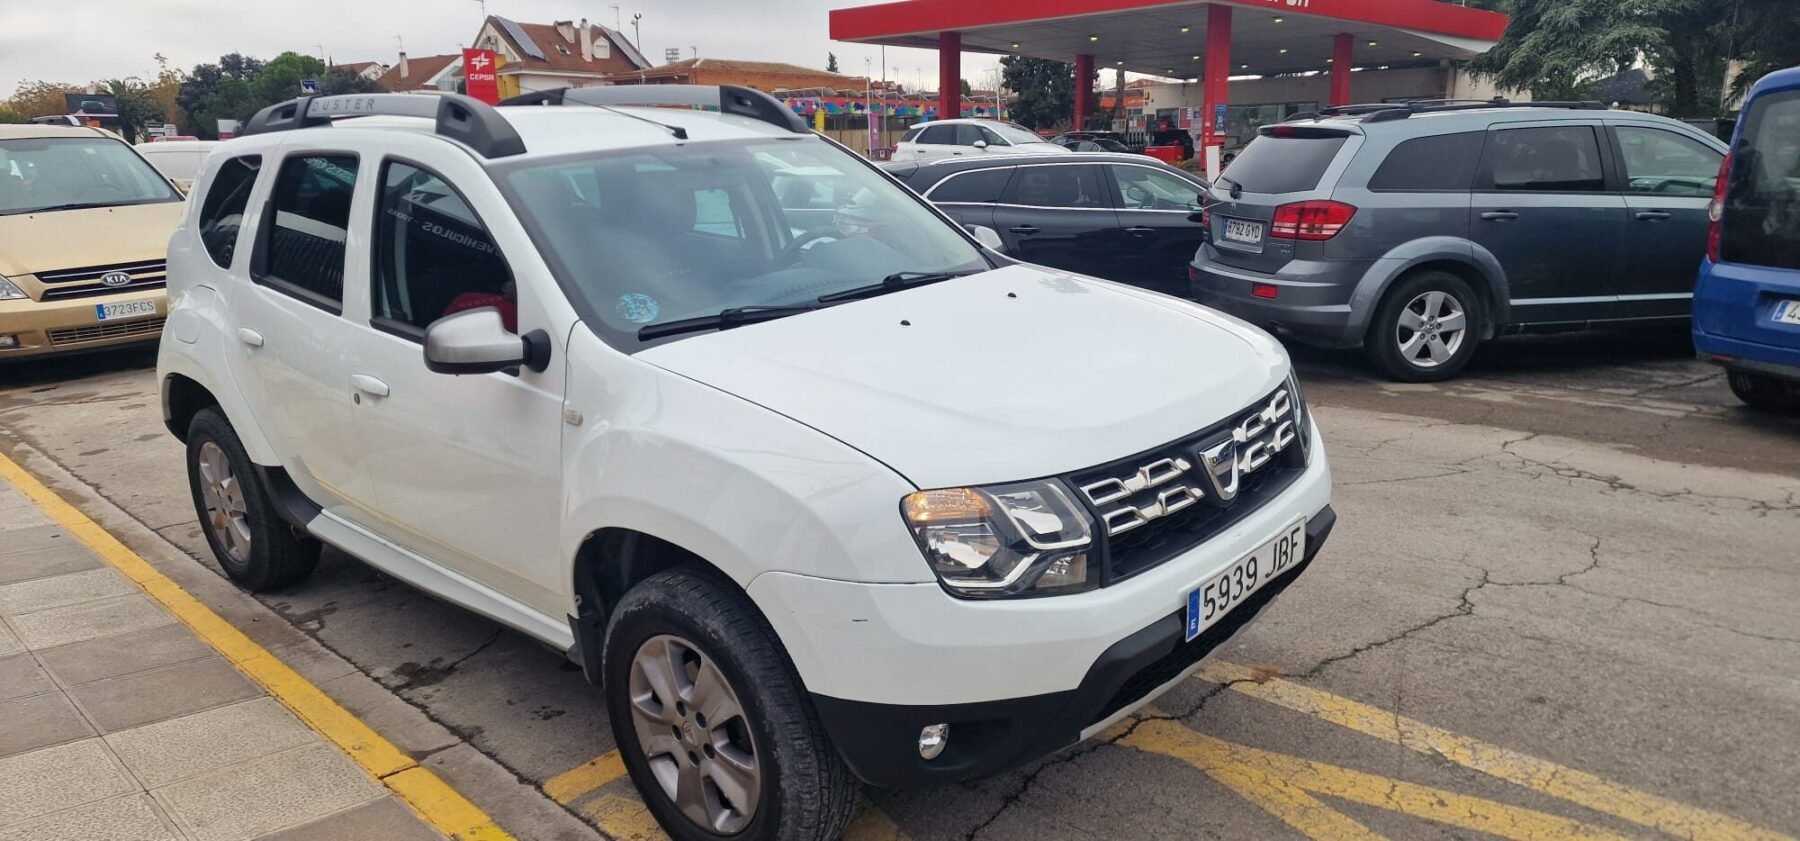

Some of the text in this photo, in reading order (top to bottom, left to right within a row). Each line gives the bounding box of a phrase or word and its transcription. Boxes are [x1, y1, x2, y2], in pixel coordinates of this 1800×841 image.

[311, 99, 376, 112] DUSTER
[1227, 221, 1245, 236] 8792
[106, 275, 127, 283] KIA
[1204, 556, 1258, 621] 5939
[1264, 526, 1301, 579] JBF
